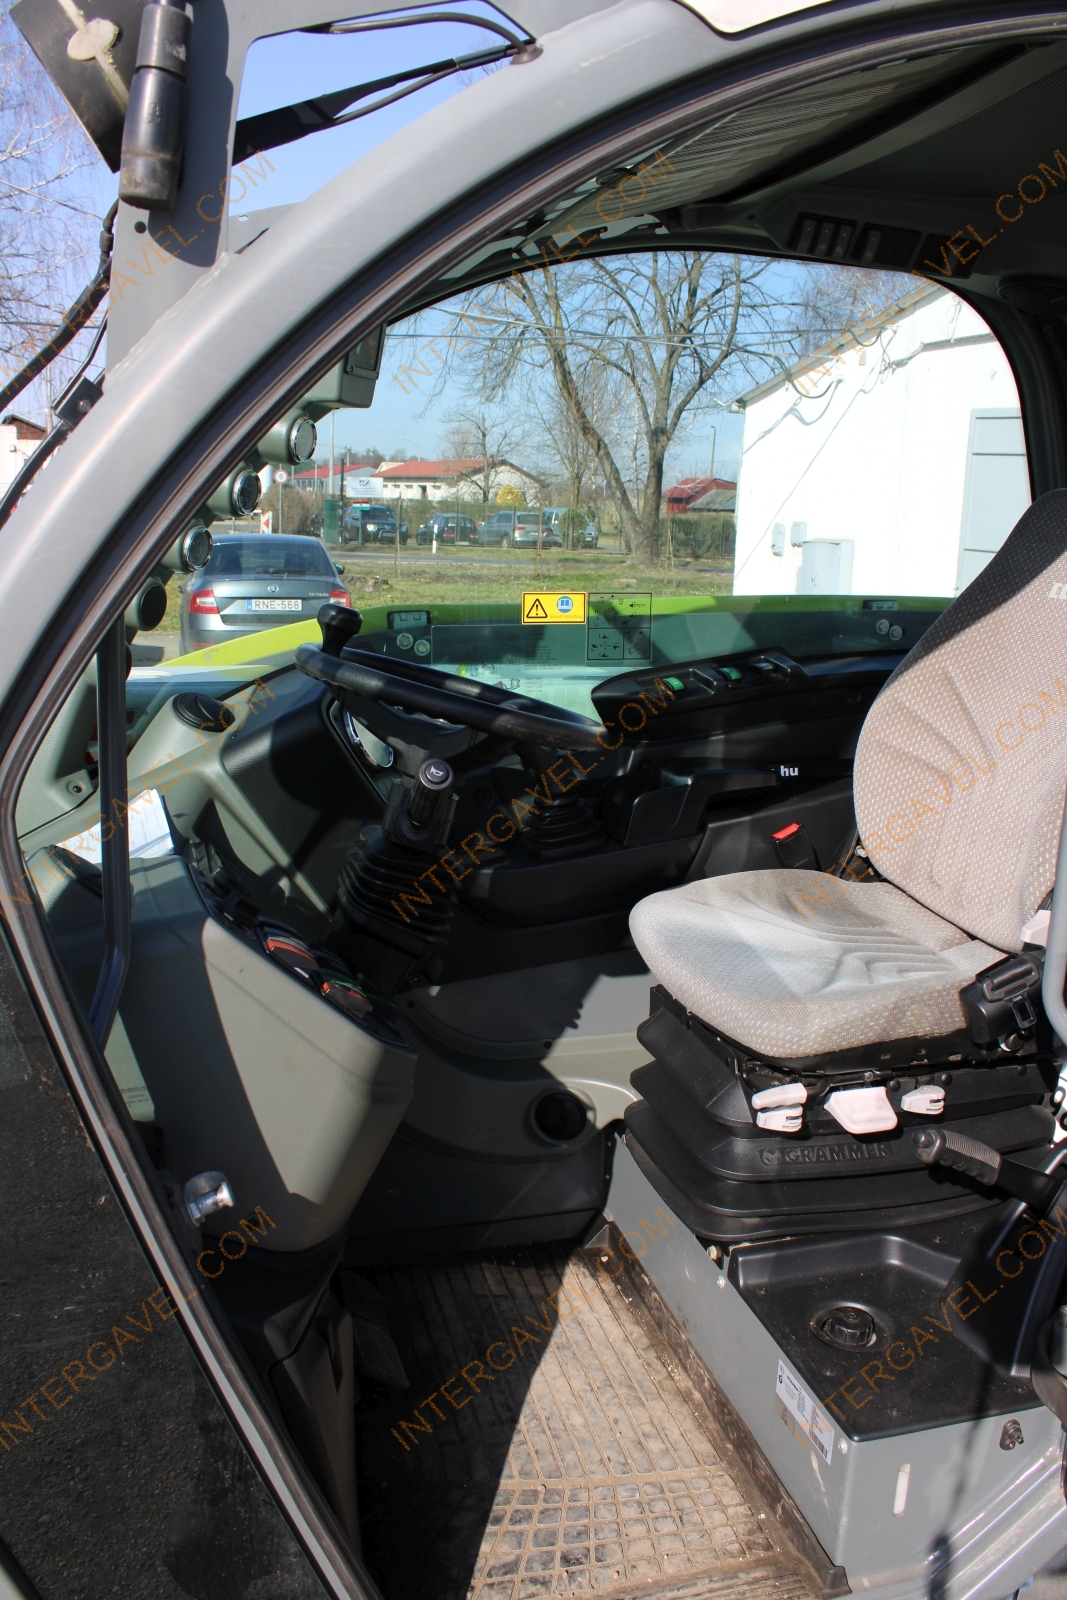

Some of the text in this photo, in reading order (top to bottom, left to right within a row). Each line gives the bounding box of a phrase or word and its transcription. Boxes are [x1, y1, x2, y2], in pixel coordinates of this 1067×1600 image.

[254, 600, 300, 609] RNE-568
[780, 765, 798, 776] hu
[785, 1142, 891, 1162] GRAMMER
